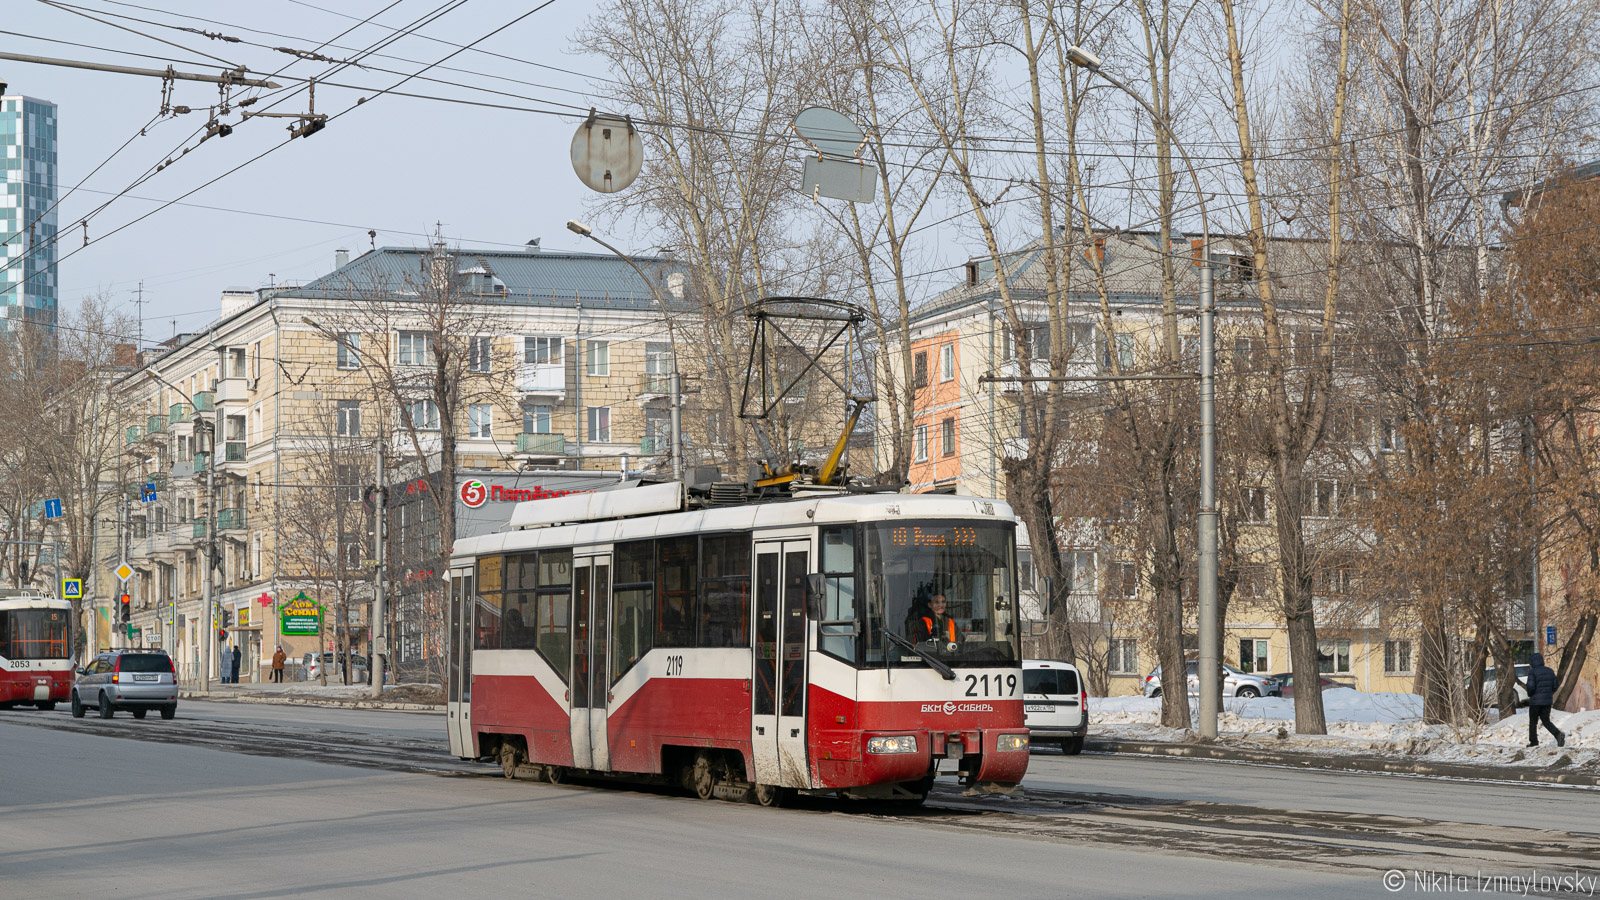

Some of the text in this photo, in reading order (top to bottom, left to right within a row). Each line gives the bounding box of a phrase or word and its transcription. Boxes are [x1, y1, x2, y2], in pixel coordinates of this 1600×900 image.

[292, 600, 313, 608] Дом
[51, 613, 58, 621] 15
[10, 660, 30, 668] 2053
[666, 655, 683, 676] 2119
[964, 674, 1017, 697] 2119
[921, 703, 994, 713] БКМ СИБИРЬ
